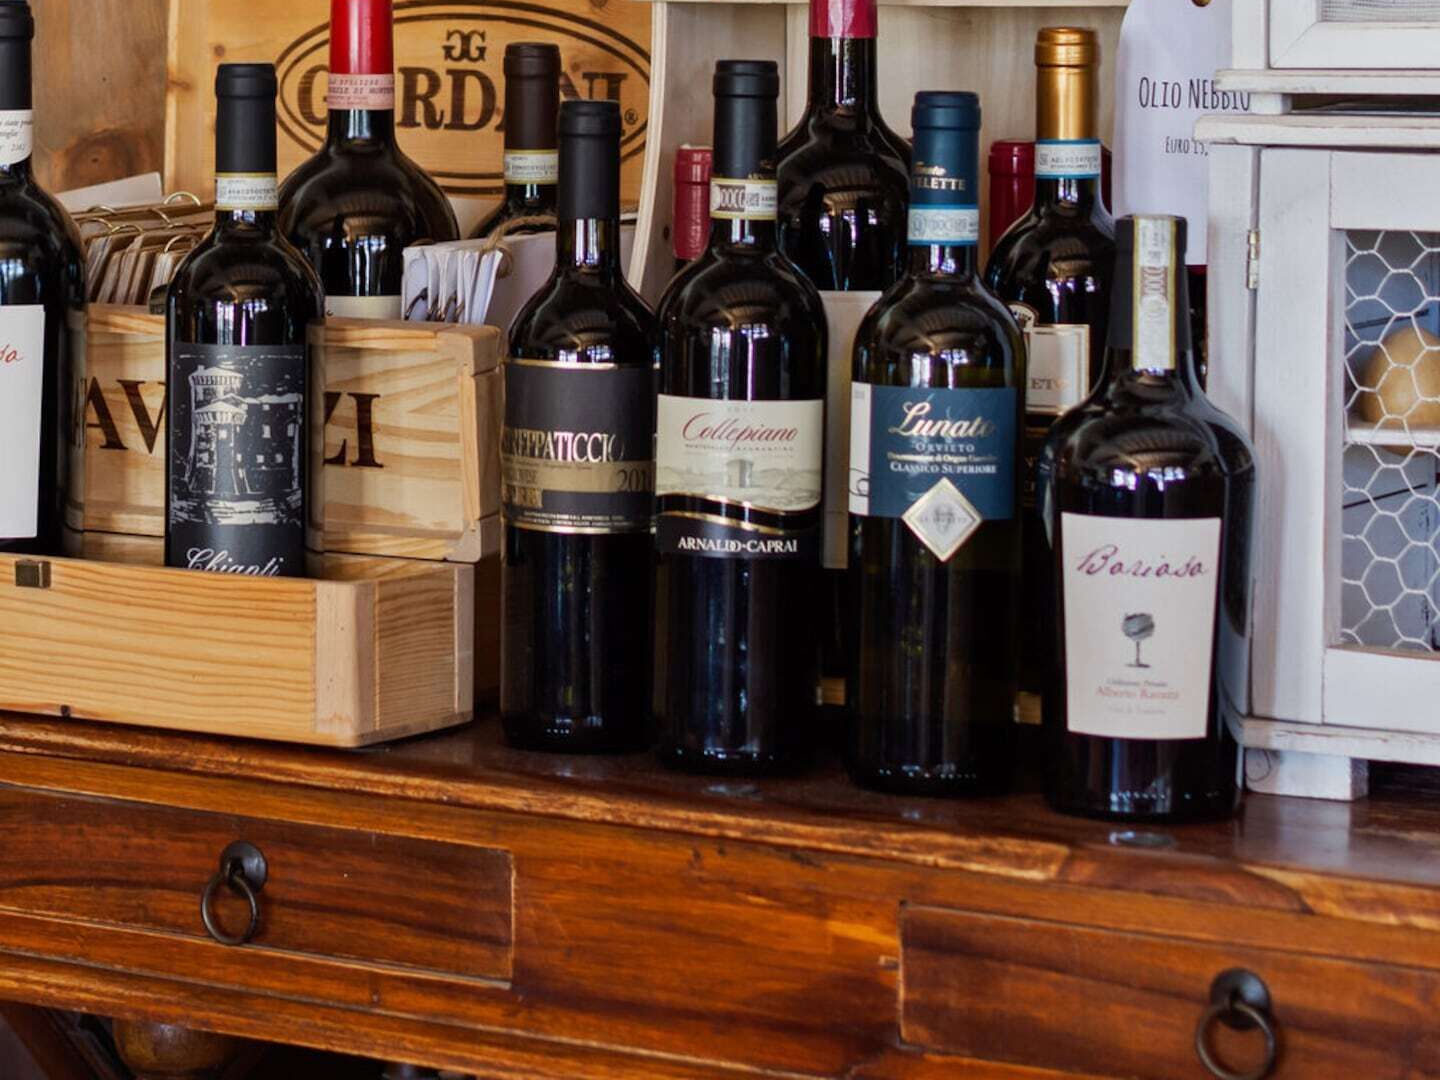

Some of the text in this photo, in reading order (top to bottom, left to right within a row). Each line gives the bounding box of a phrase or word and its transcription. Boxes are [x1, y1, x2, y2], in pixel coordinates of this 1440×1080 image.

[1138, 76, 1182, 109] OLIO
[1165, 136, 1189, 155] EURO
[682, 412, 799, 452] Collepiano
[915, 441, 975, 453] ORVIETO
[890, 461, 997, 474] CLASSICO SUPERIORE
[186, 546, 285, 577] Chianti
